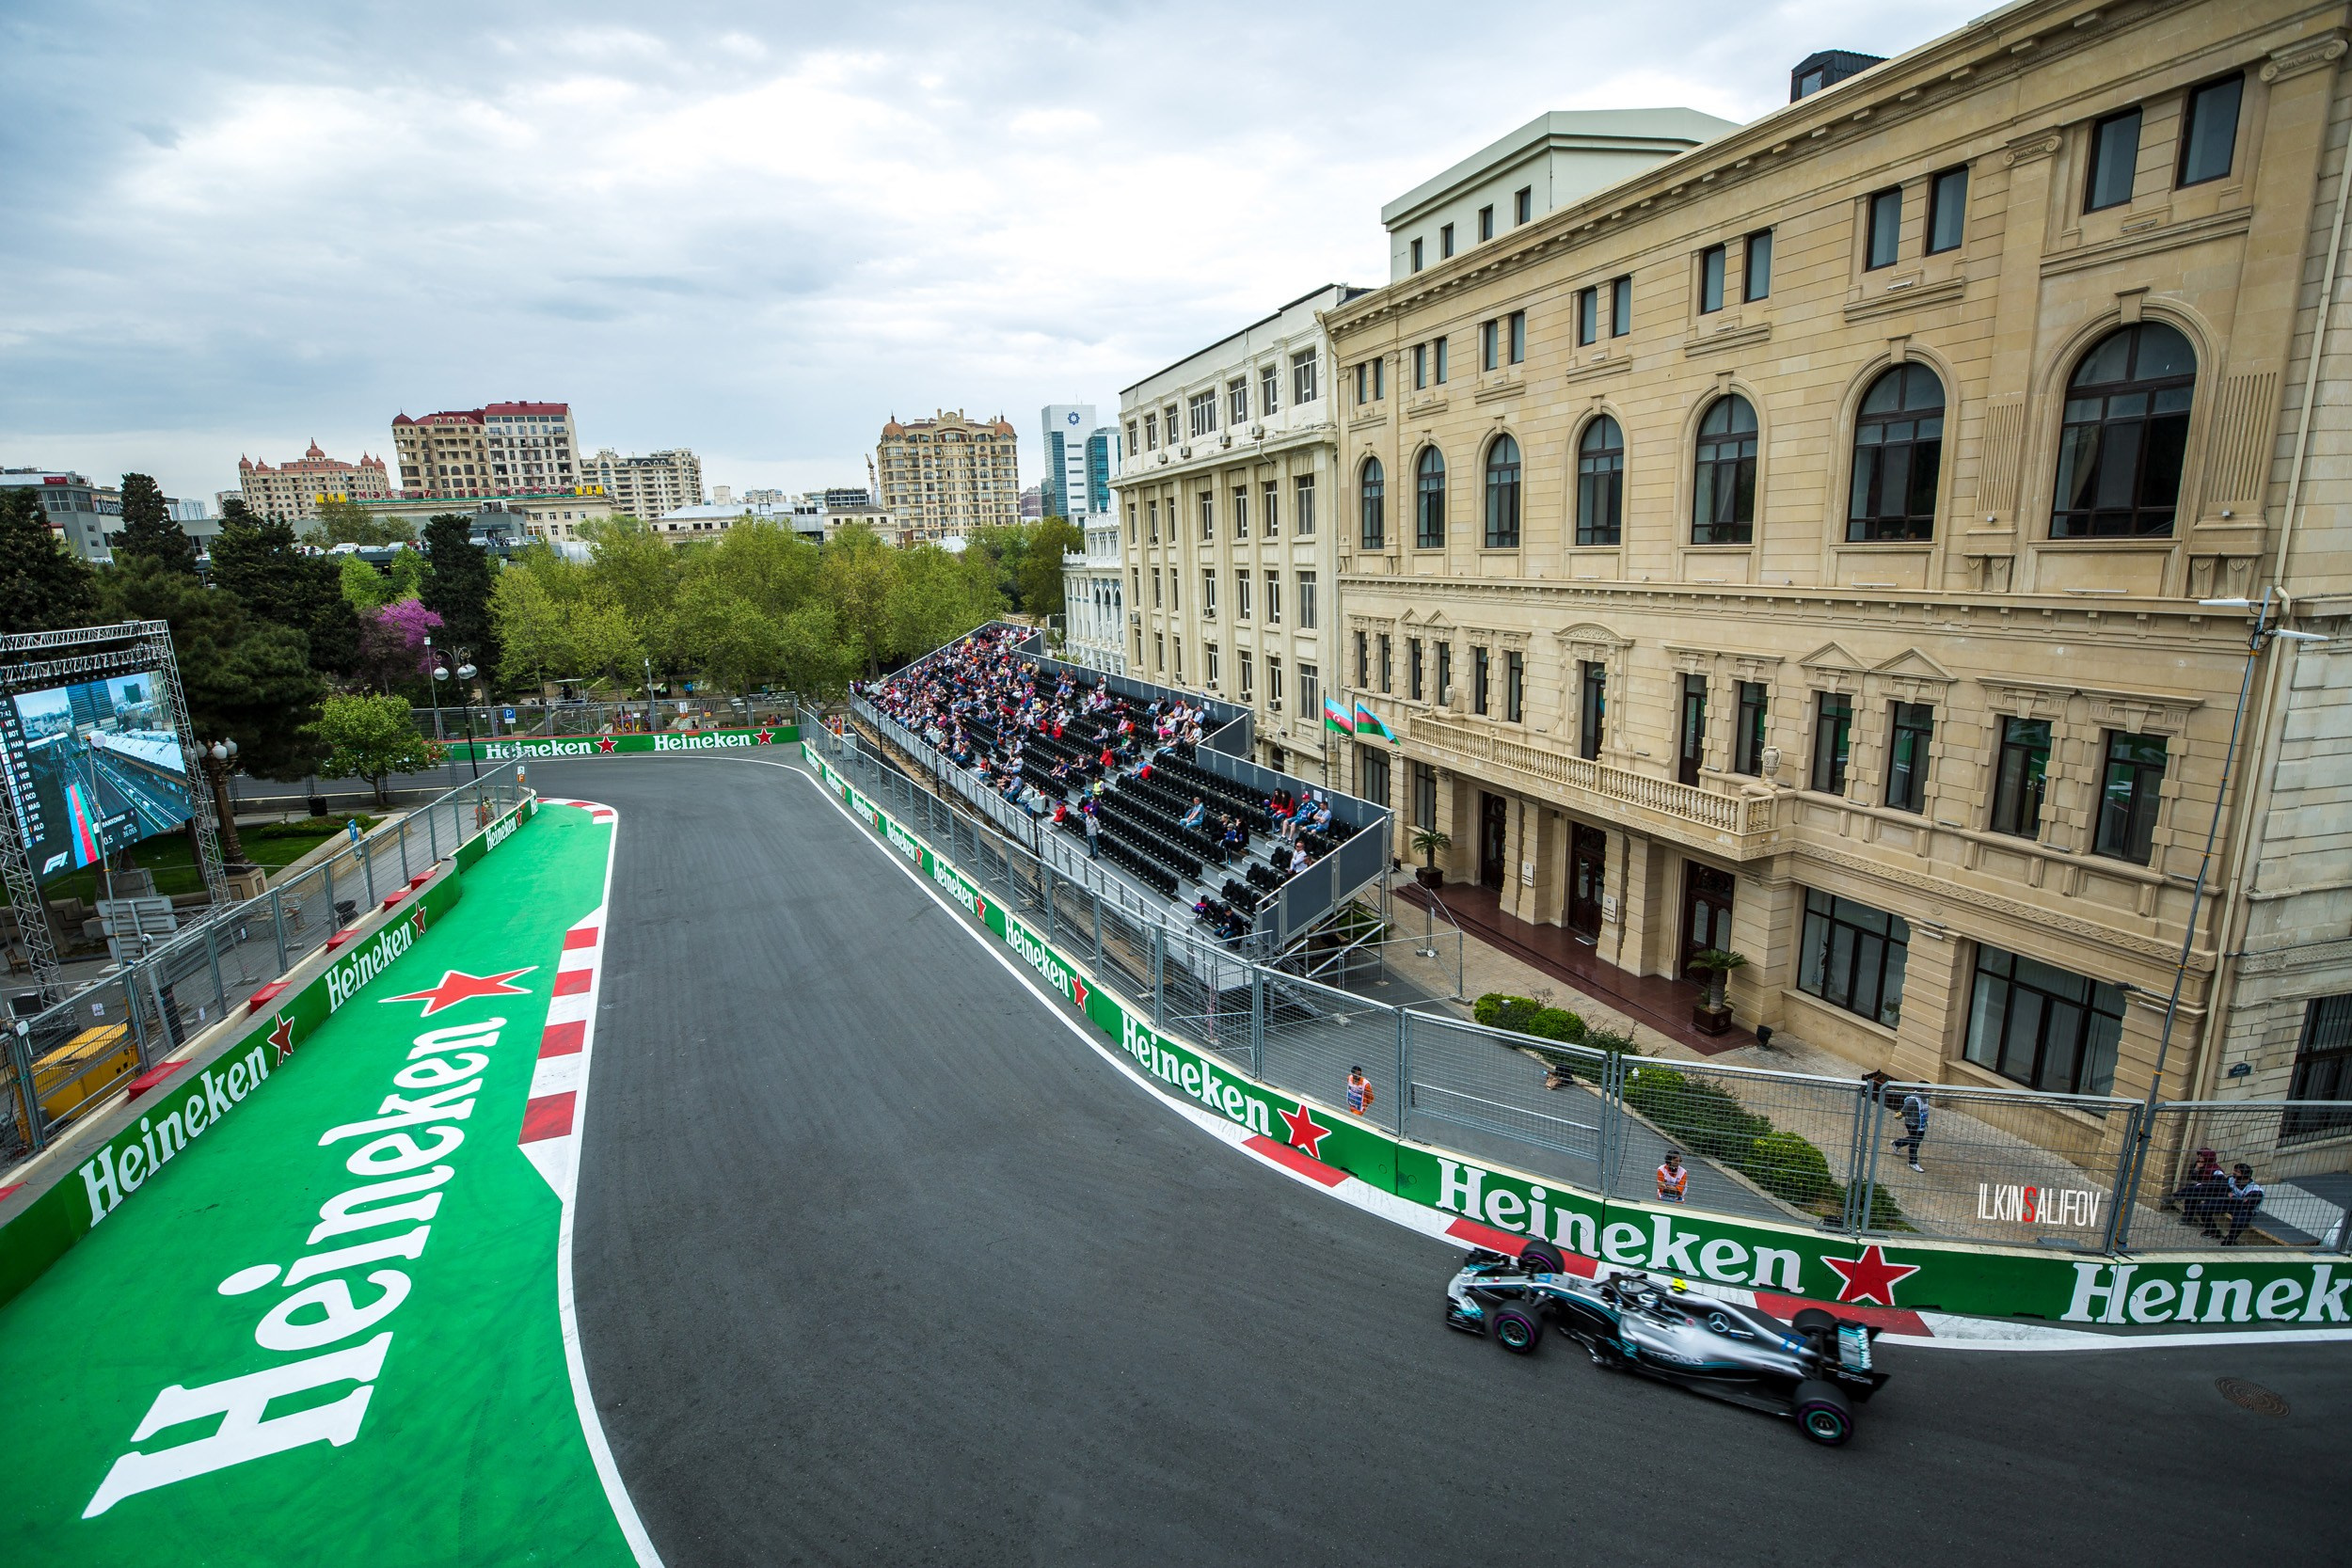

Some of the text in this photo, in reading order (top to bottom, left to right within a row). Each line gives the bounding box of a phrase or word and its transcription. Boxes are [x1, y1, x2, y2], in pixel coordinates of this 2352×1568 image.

[485, 739, 592, 759] Heineken
[654, 732, 751, 752] Heineken
[485, 816, 516, 852] Heineken
[885, 816, 915, 863] Heineken
[932, 856, 975, 914] Heineken
[325, 925, 413, 1013] Heineken
[1004, 912, 1070, 997] Heineken
[1120, 1009, 1272, 1138] Heineken
[79, 1045, 270, 1227] Heineken
[1436, 1157, 1805, 1295] Heineken
[82, 1017, 506, 1519] Heineken
[2060, 1261, 2352, 1324] Heinek
